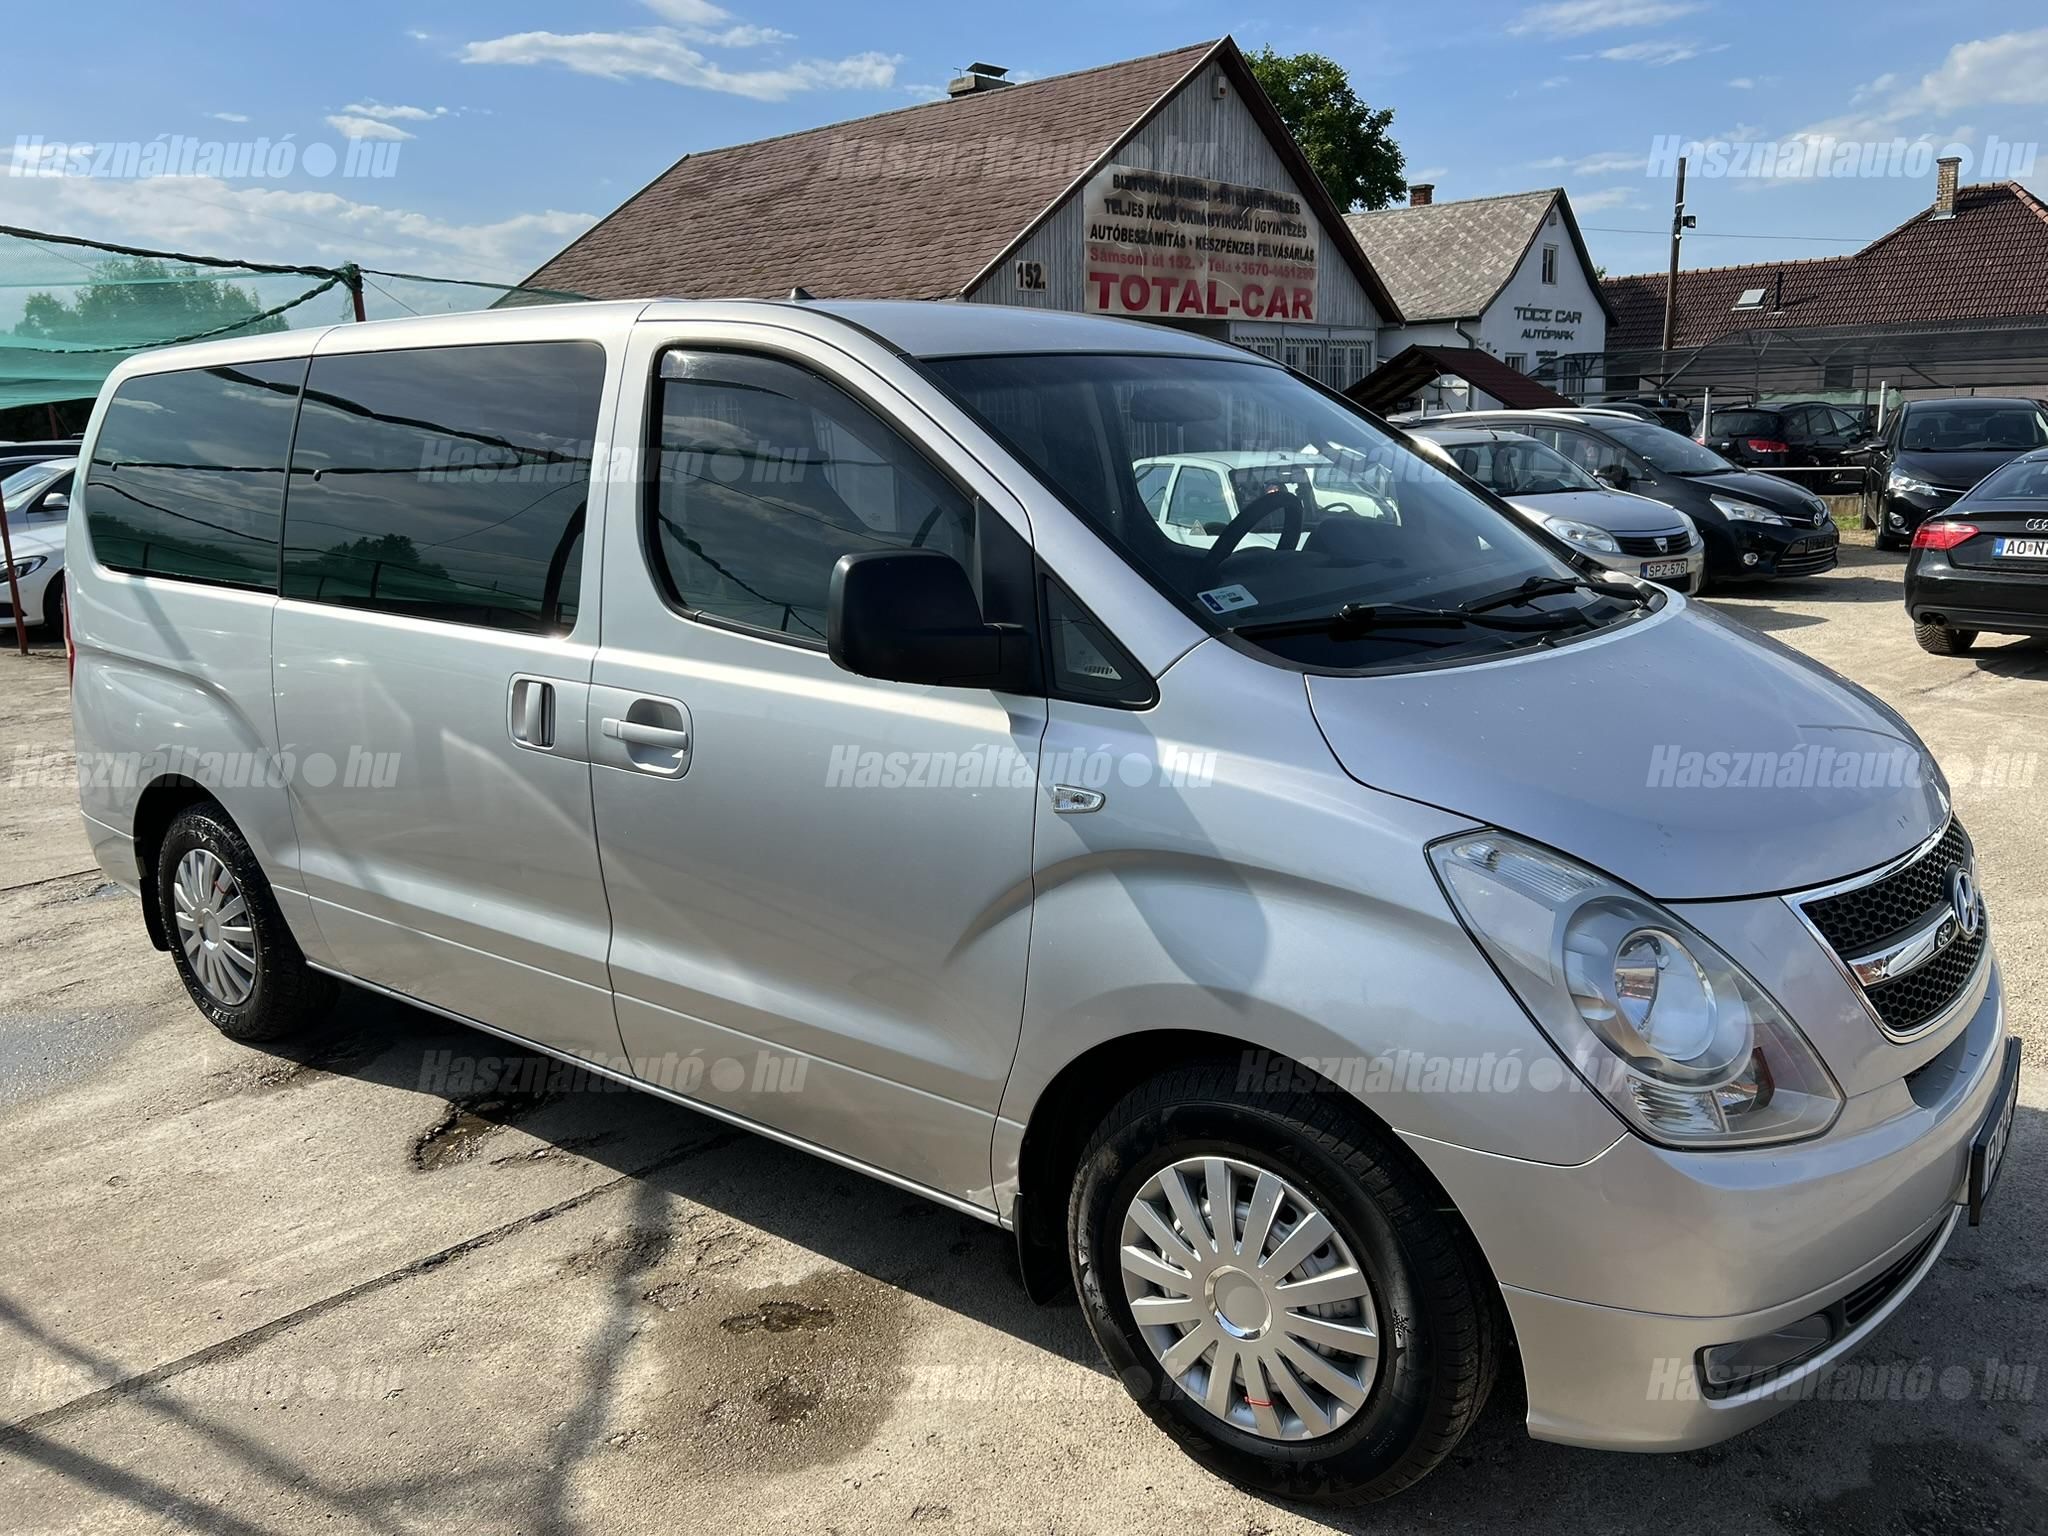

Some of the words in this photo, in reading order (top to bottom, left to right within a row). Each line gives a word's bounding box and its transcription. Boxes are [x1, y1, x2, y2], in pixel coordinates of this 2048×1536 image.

[1104, 198, 1144, 219] TELJES
[1254, 218, 1307, 239] ÜGYINTÉZÉS
[1090, 224, 1186, 248] AUTÓBESZÁMÍTÁS
[1195, 235, 1255, 257] KÉSZPÉNZES
[1257, 242, 1315, 263] FELVÁSÁRLÁS
[1017, 262, 1045, 289] 152.
[1089, 271, 1313, 320] TOTAL-CAR
[1555, 310, 1582, 324] CAR
[1521, 326, 1575, 341] AUTÓPARK
[1648, 562, 1685, 577] SPZ-576
